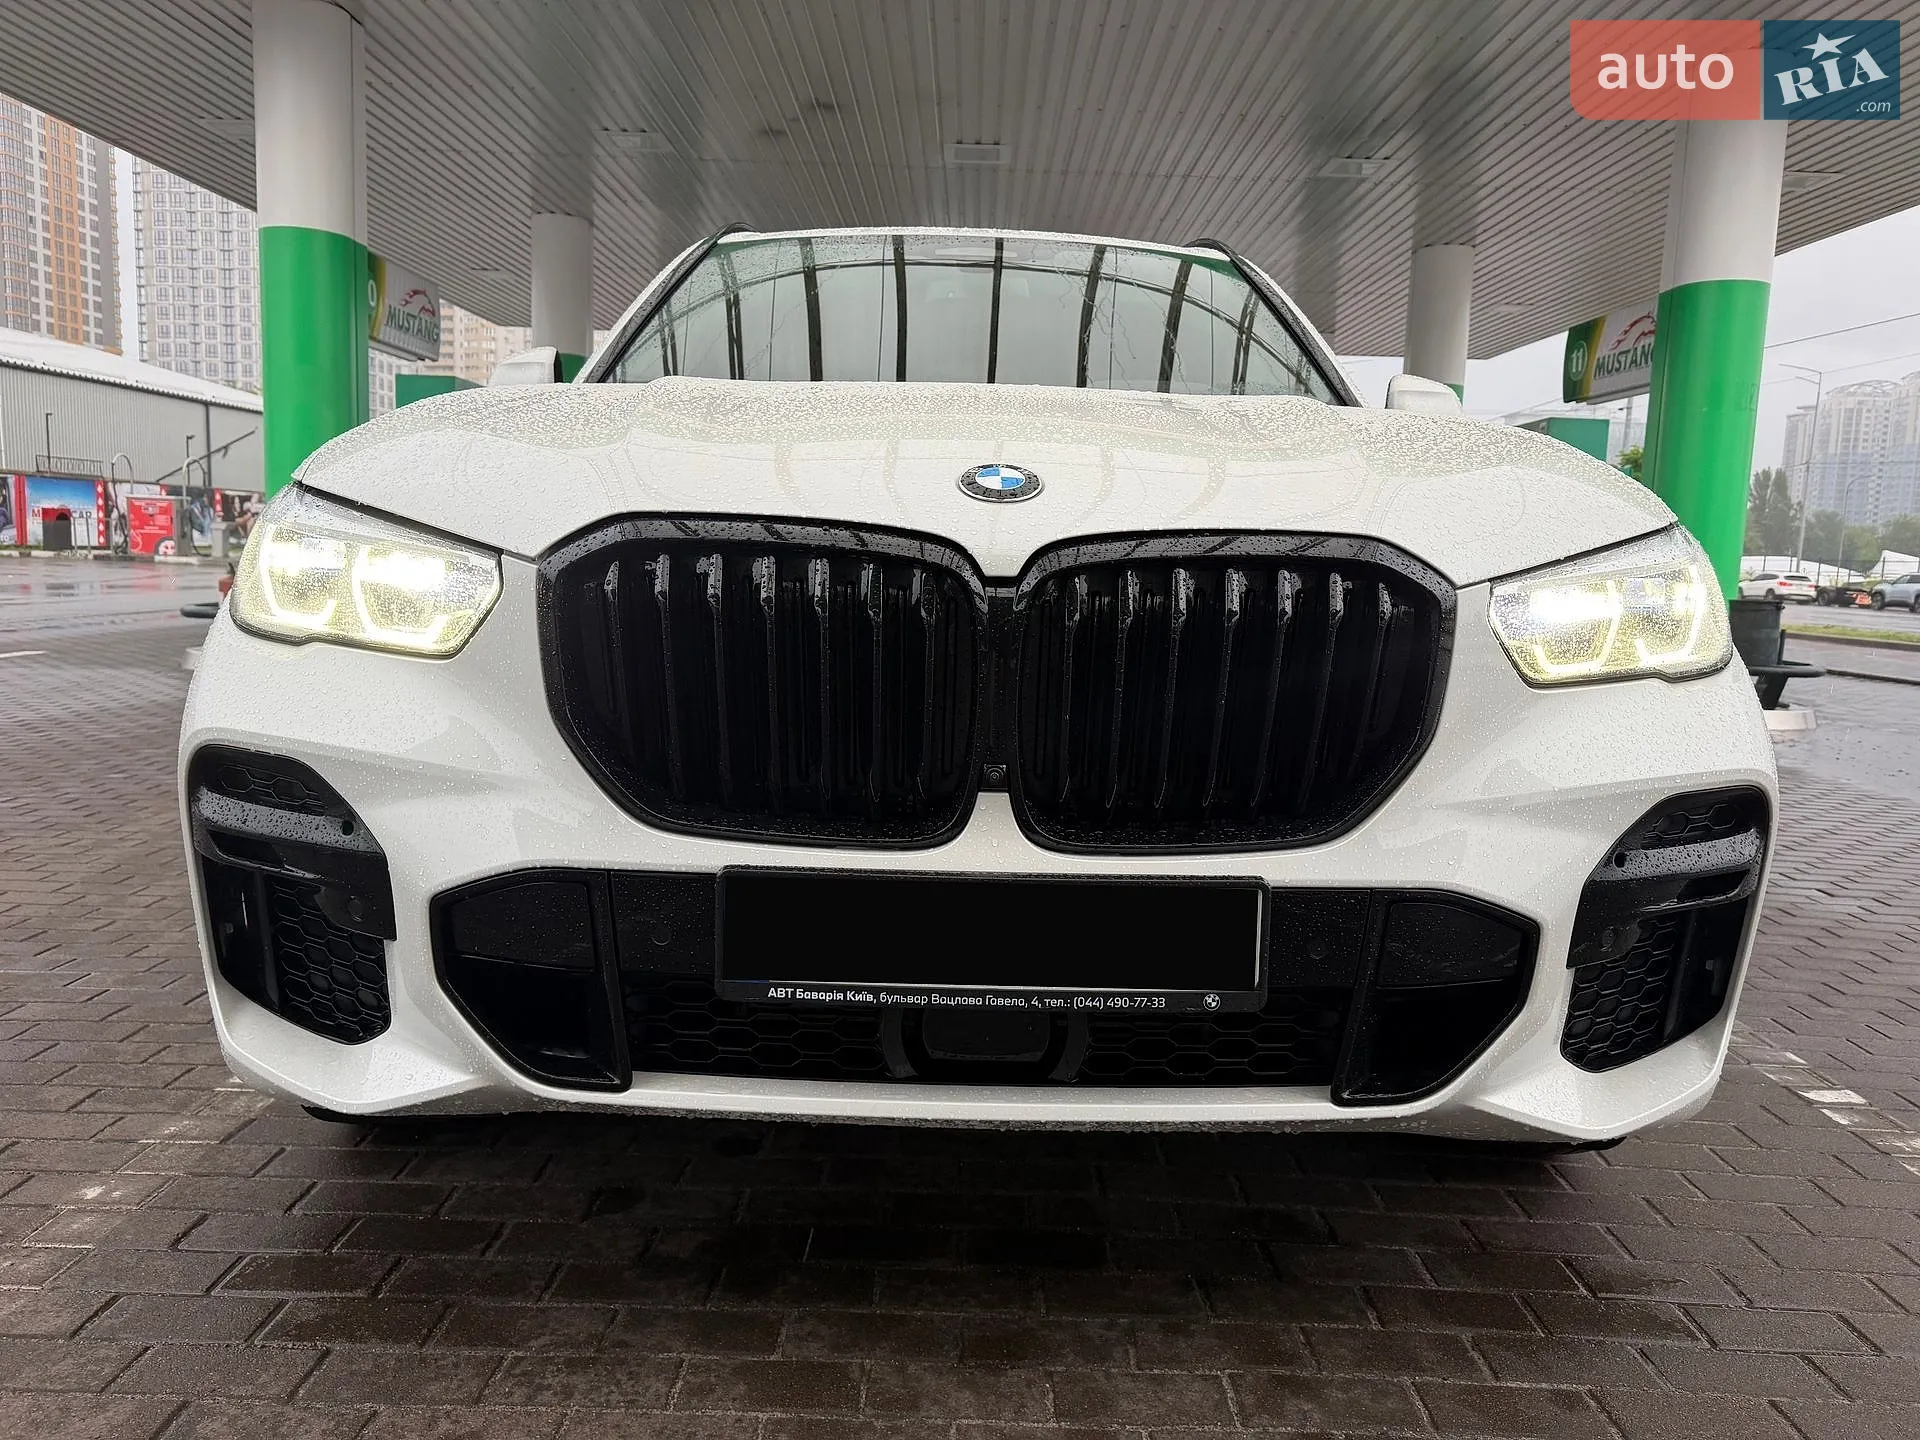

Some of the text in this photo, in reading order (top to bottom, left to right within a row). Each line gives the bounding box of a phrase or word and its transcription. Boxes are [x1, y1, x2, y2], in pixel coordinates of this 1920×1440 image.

[384, 303, 440, 343] MUSTANG
[1570, 347, 1584, 374] 11
[768, 987, 1166, 1010] АВТ Баварія Київ, бульвар Вацлава Гавела, 4, тел.: (044) 490-77-33
